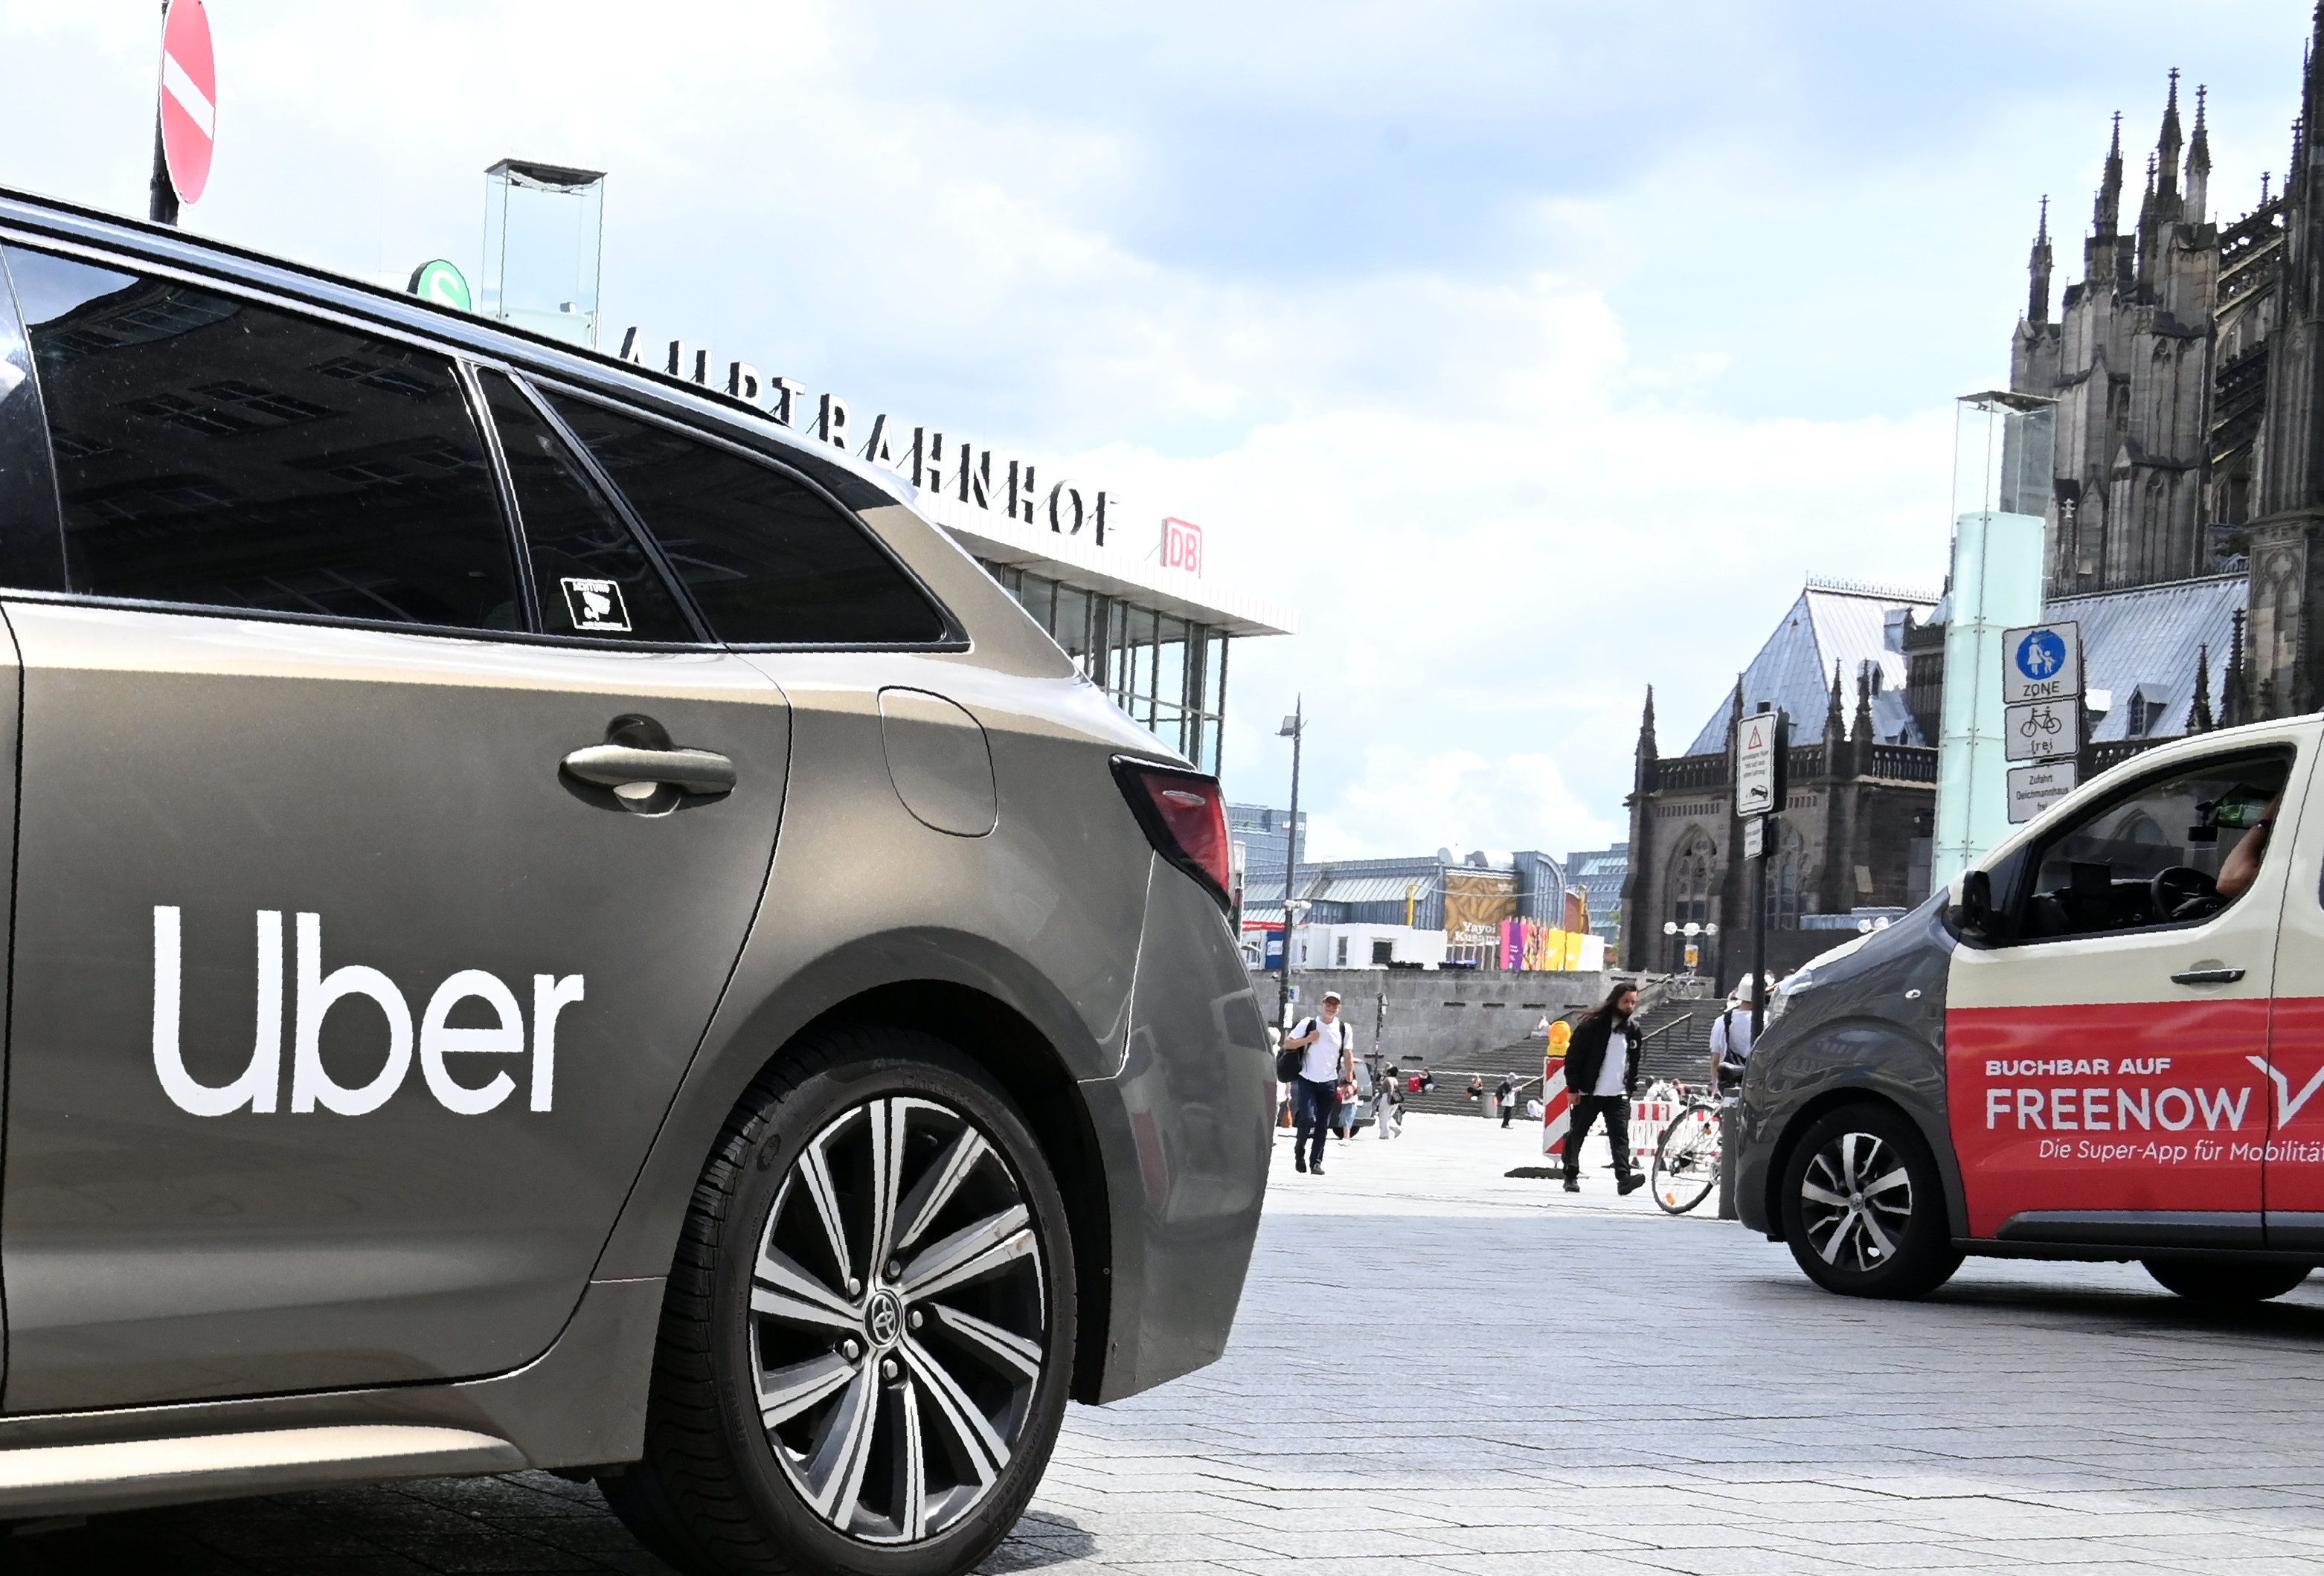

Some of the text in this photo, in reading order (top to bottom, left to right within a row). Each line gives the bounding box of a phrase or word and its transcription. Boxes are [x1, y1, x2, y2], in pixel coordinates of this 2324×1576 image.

[429, 269, 460, 306] S
[619, 323, 1120, 547] AUPTBAHNHOF
[1169, 526, 1199, 573] DB
[2023, 681, 2061, 697] ZONE
[2031, 739, 2053, 753] frei
[2029, 773, 2053, 785] Zufahrt
[2016, 787, 2069, 800] Deichmannhaus
[1462, 921, 1496, 935] Yayoi
[153, 904, 585, 1117] Uber
[1985, 1057, 2171, 1075] BUCHBAR AUF
[1986, 1087, 2251, 1131] FREENOW
[2038, 1138, 2071, 1159] Die
[2076, 1139, 2188, 1165] Super-App
[2193, 1139, 2223, 1163] für
